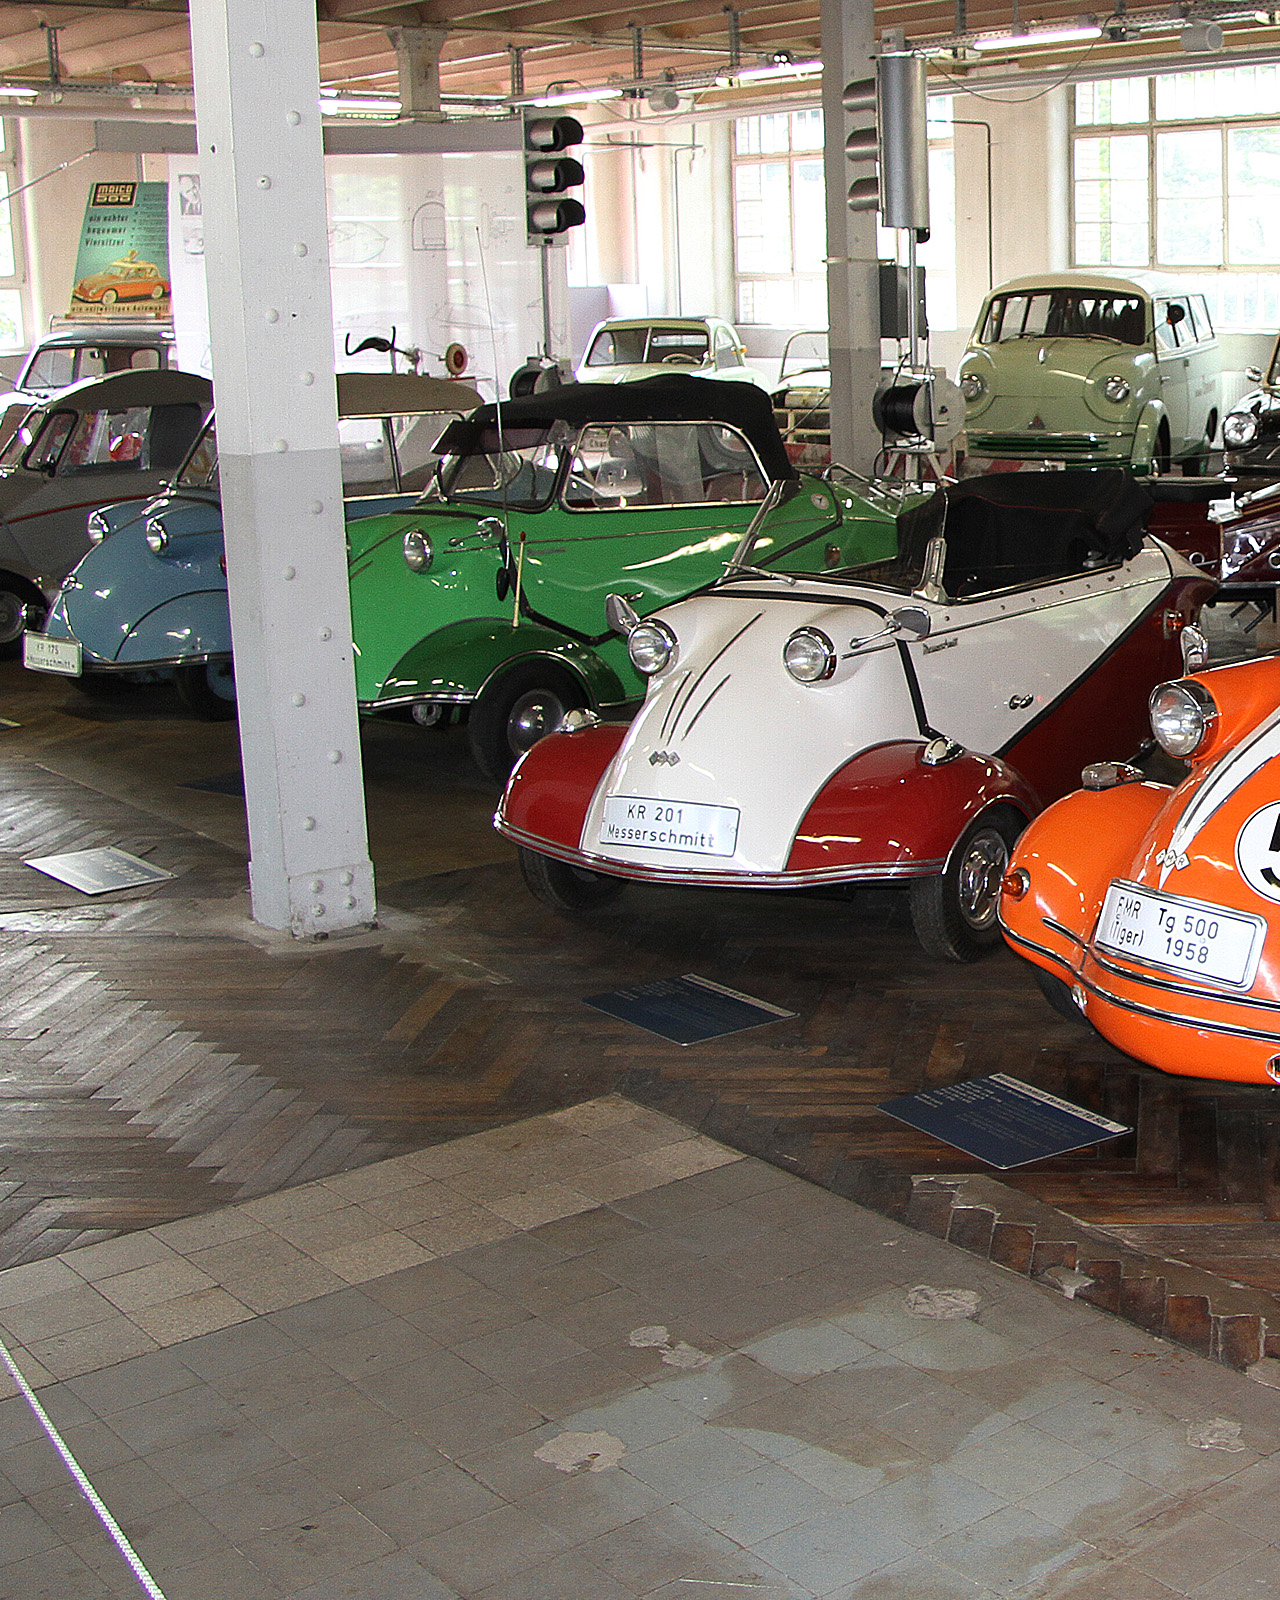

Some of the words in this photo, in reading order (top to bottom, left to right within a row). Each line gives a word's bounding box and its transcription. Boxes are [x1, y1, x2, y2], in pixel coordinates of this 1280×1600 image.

[627, 803, 646, 820] KR
[655, 806, 683, 824] 201
[607, 823, 715, 848] Messerschmitt
[1116, 896, 1142, 920] FMR
[1158, 907, 1176, 934] Tg
[1183, 915, 1219, 940] 500
[1109, 918, 1145, 947] (Tiger)
[1166, 937, 1209, 964] 1958
